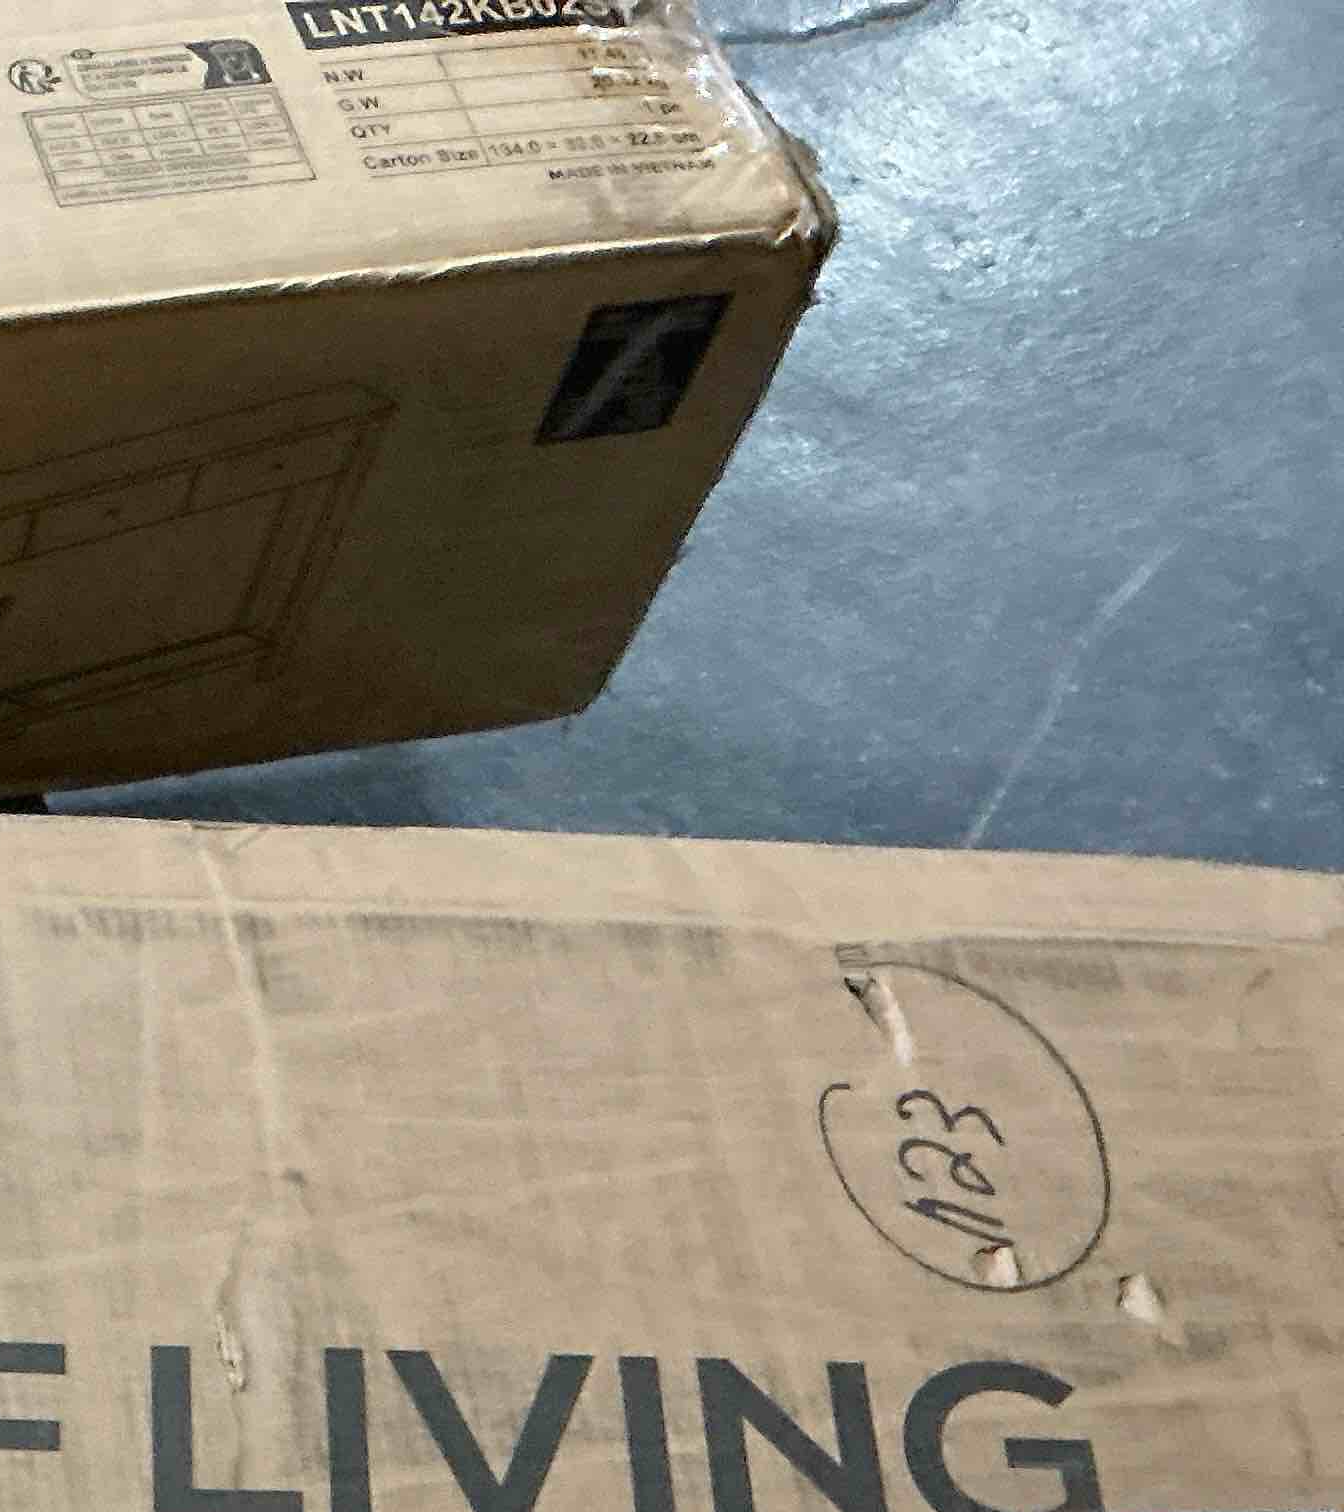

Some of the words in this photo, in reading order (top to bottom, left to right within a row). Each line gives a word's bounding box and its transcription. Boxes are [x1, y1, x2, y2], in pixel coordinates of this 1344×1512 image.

[351, 122, 392, 138] QTY
[364, 151, 431, 170] Carton
[438, 147, 479, 164] Size
